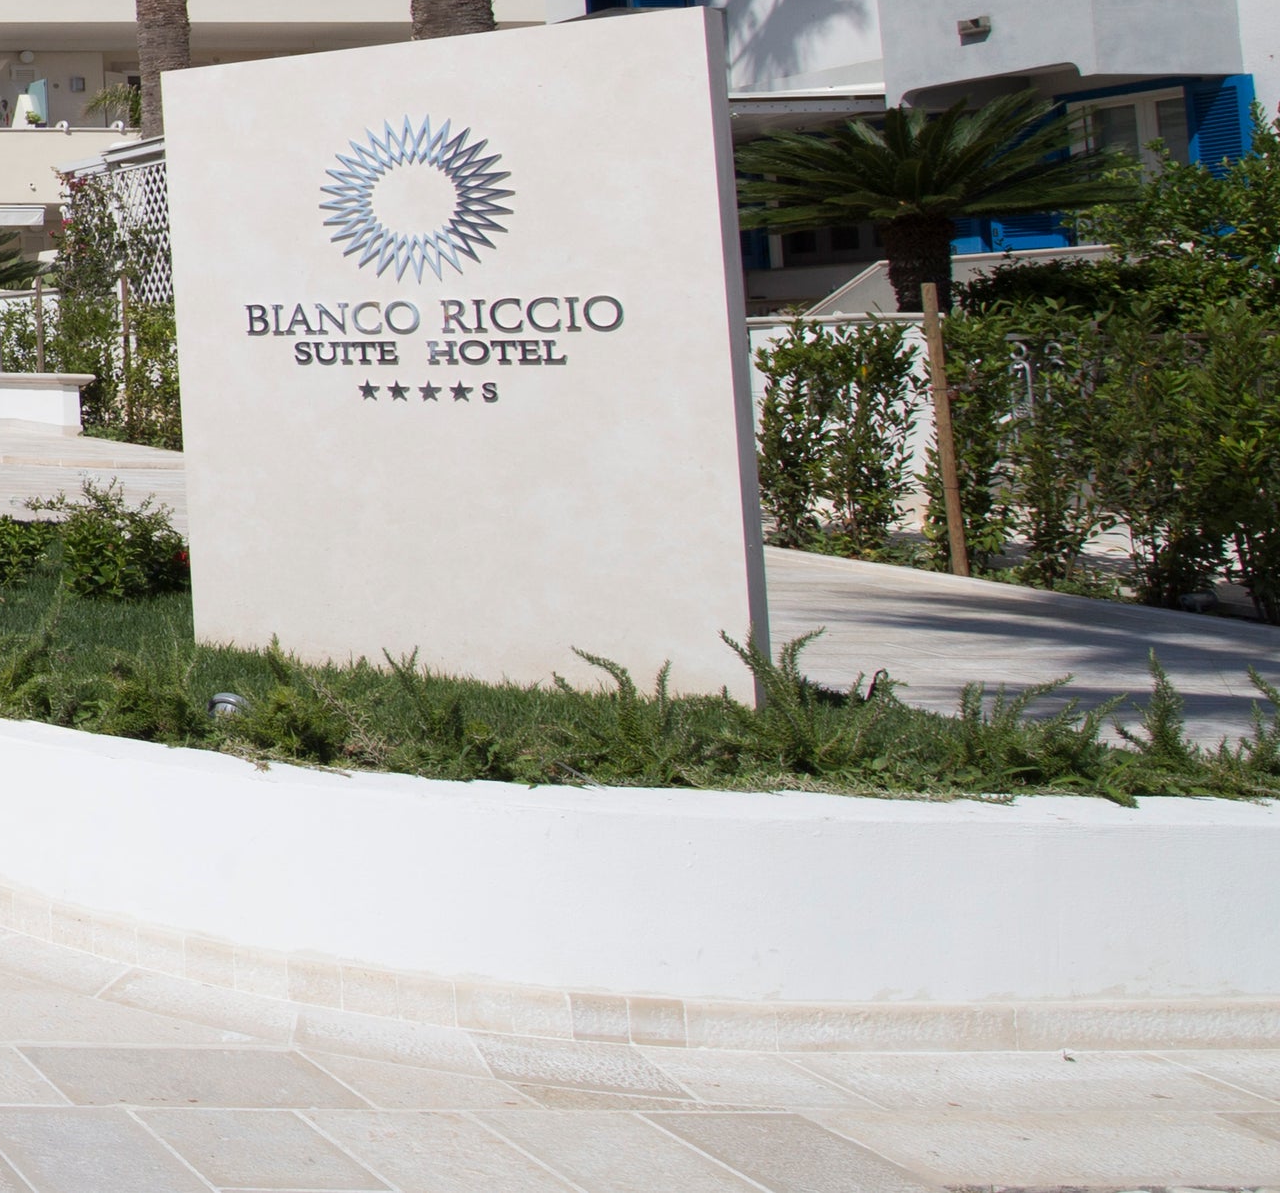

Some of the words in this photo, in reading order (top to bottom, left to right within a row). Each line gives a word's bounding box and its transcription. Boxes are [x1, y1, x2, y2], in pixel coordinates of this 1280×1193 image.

[244, 300, 420, 335] BIANCO
[440, 295, 624, 333] RICCIO
[295, 341, 399, 365] SUITE
[426, 339, 567, 365] HOTEL
[482, 382, 498, 402] S
